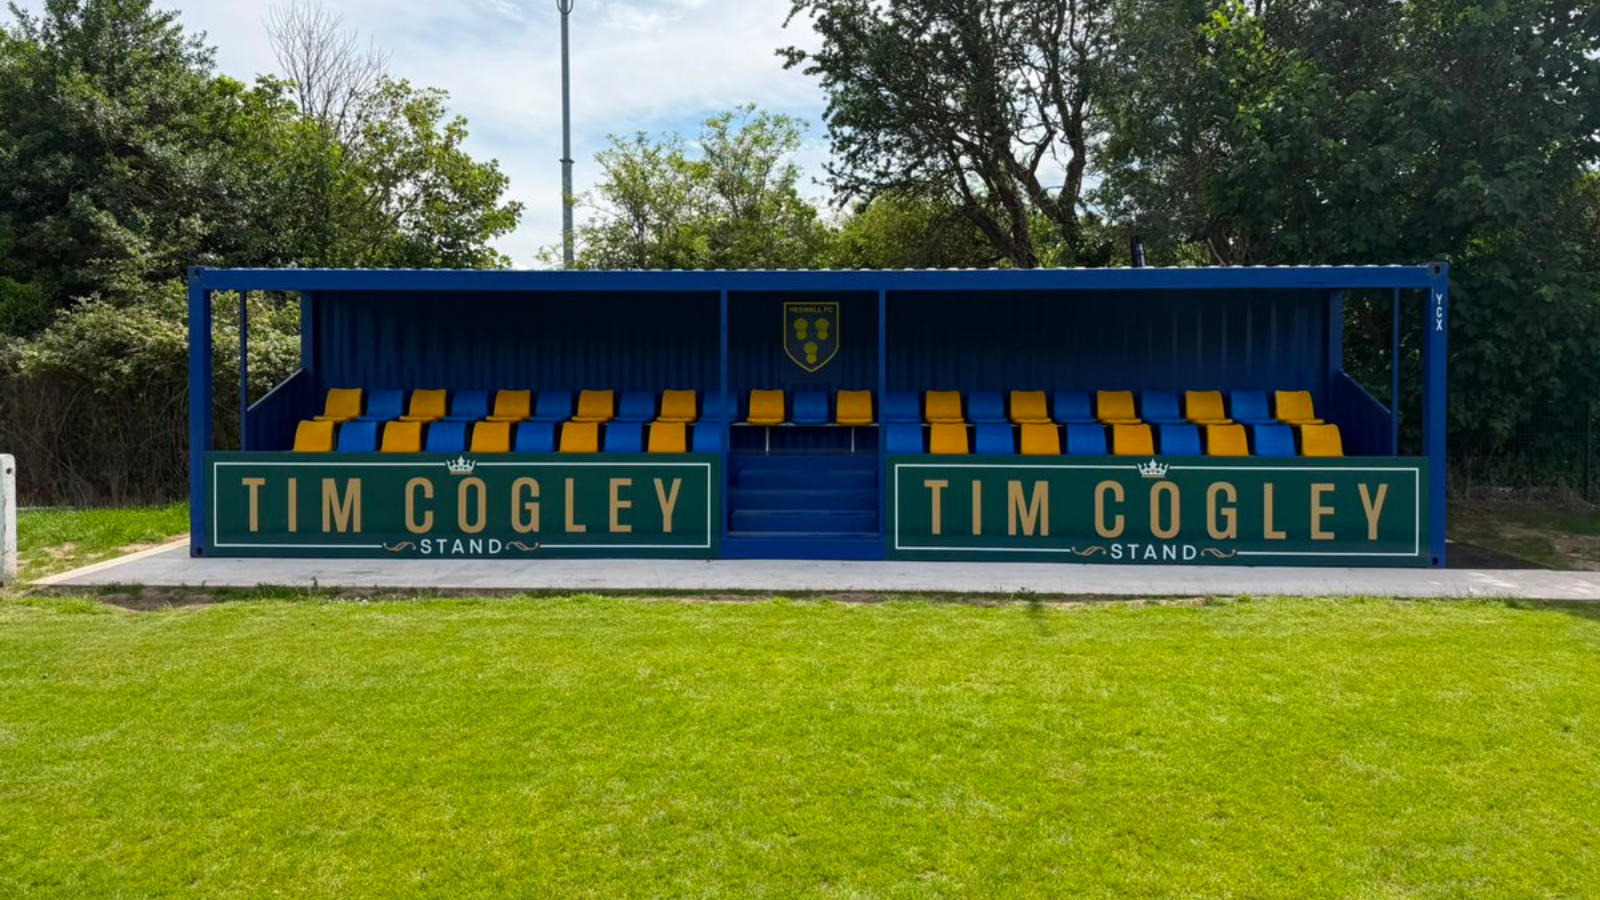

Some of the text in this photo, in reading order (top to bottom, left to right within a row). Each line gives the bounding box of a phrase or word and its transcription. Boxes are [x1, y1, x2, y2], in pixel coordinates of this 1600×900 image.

[1435, 293, 1443, 331] YCX
[242, 477, 682, 533] TIM COGLEY
[924, 479, 1388, 540] TIM COGLEY
[419, 538, 502, 554] STAND
[1110, 543, 1197, 561] STAND
